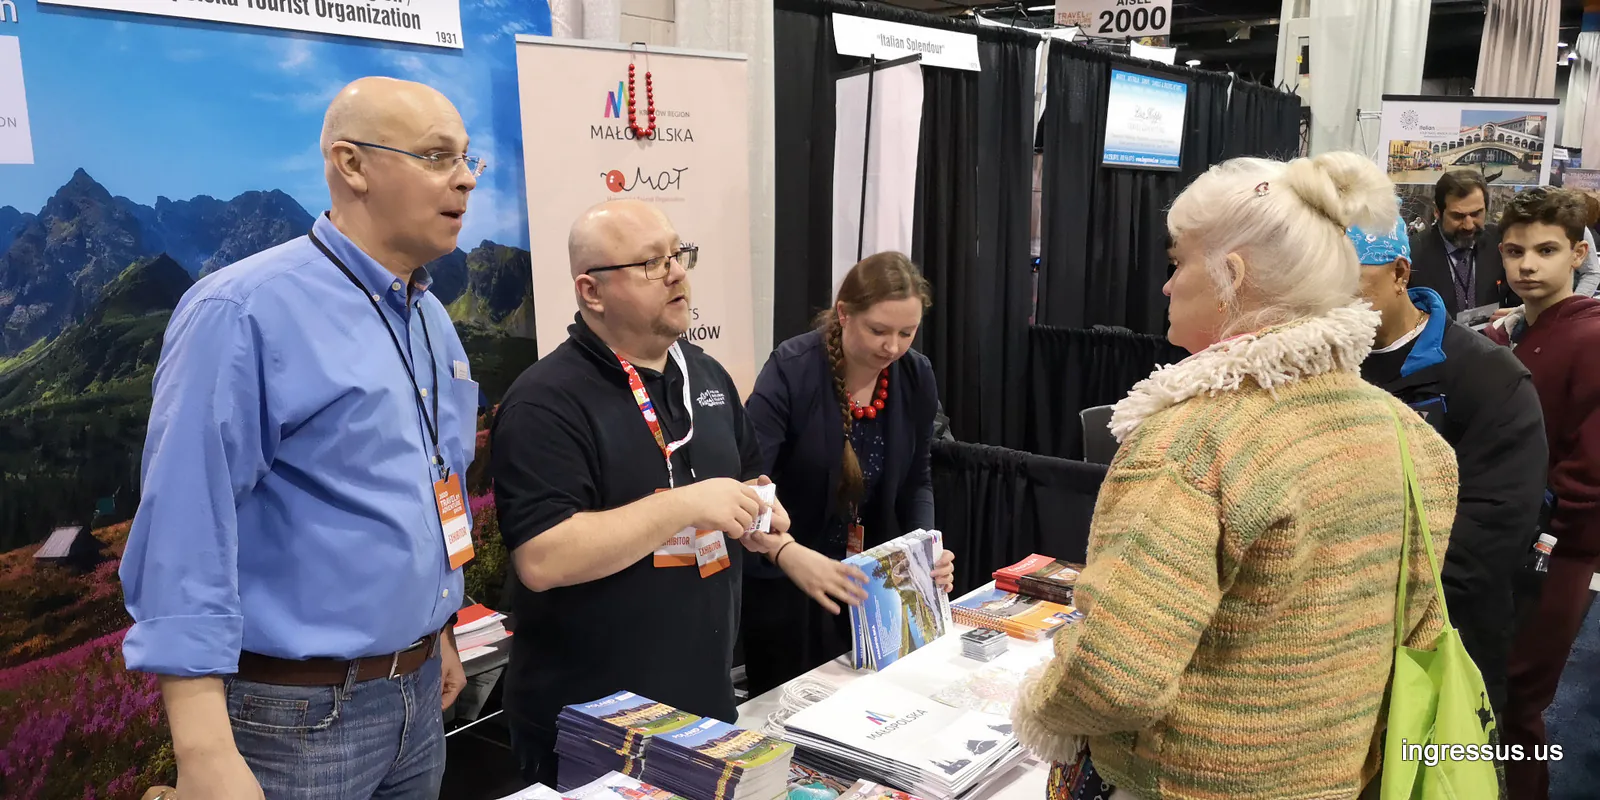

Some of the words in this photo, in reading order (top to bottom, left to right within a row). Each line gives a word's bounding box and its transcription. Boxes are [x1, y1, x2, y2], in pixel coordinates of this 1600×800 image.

[315, 0, 421, 30] Organization
[1058, 11, 1085, 19] TRAVEL
[1098, 6, 1166, 33] 2000
[436, 31, 457, 45] 1931
[590, 125, 694, 142] MAŁOOLSKA
[662, 537, 690, 546] HIBITOR
[699, 541, 721, 556] EXHIBITOR
